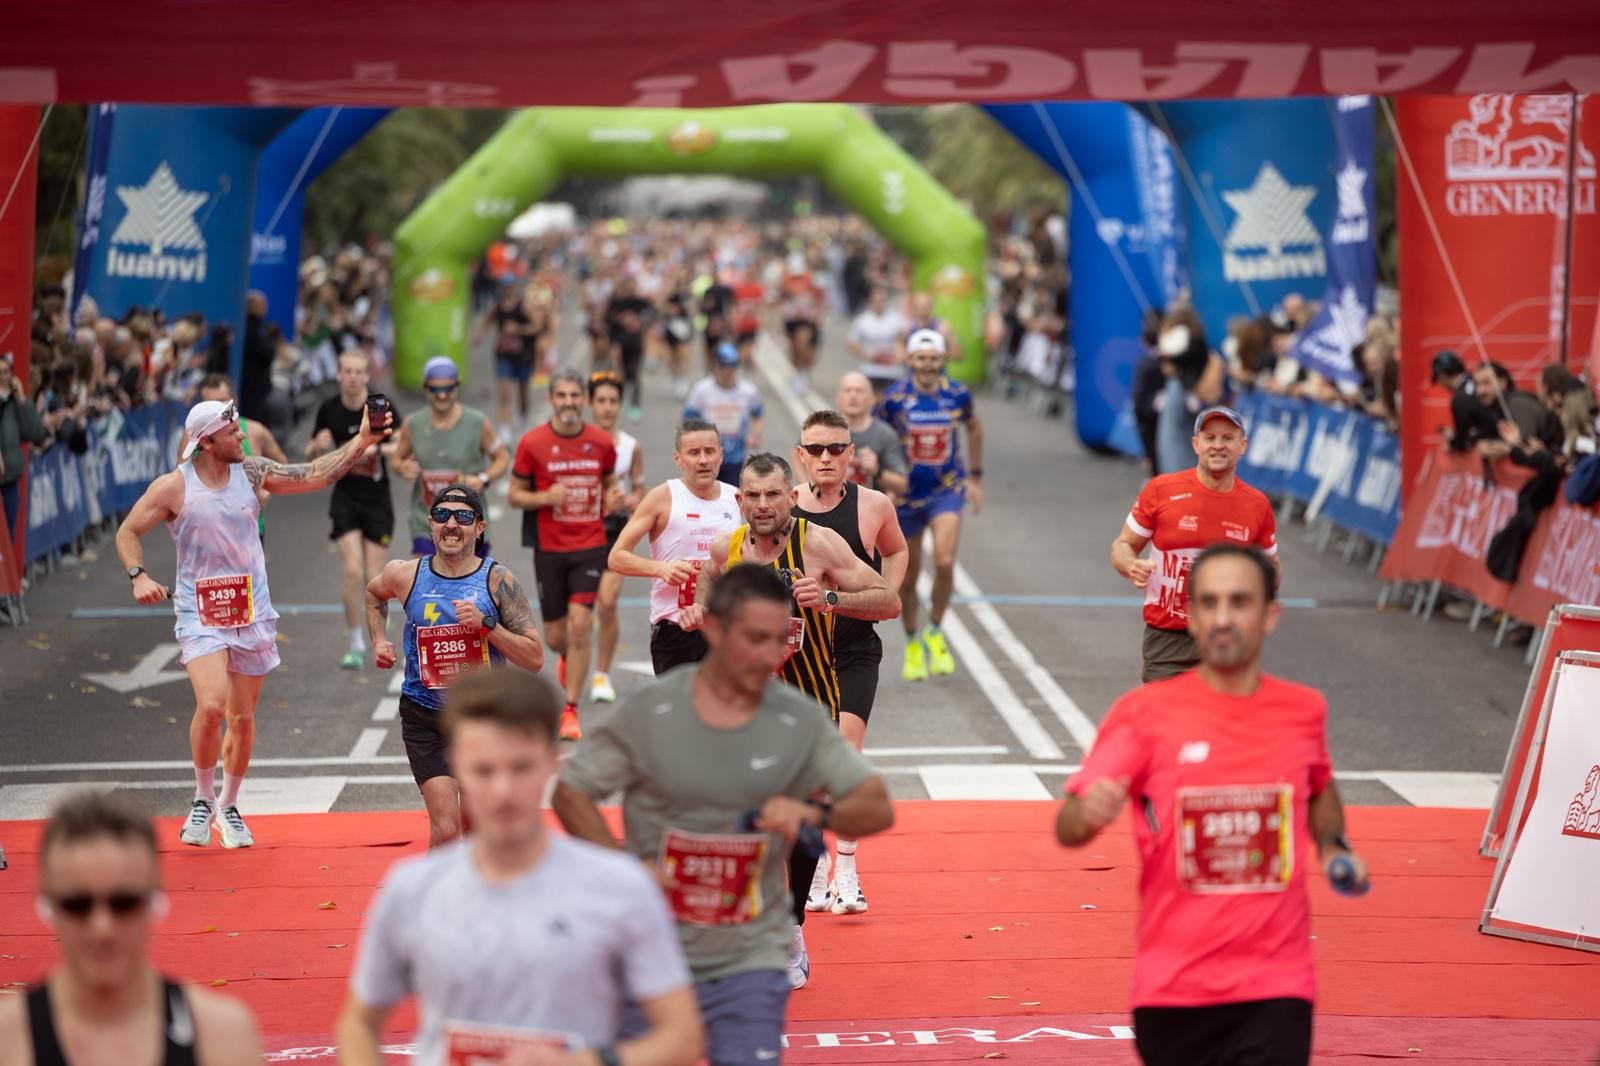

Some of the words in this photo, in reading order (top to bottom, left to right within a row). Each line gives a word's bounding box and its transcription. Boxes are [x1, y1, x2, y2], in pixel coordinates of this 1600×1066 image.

[1446, 183, 1596, 216] GENERLI
[107, 247, 207, 283] luanvi
[208, 588, 236, 600] 3439
[432, 640, 467, 653] 2386
